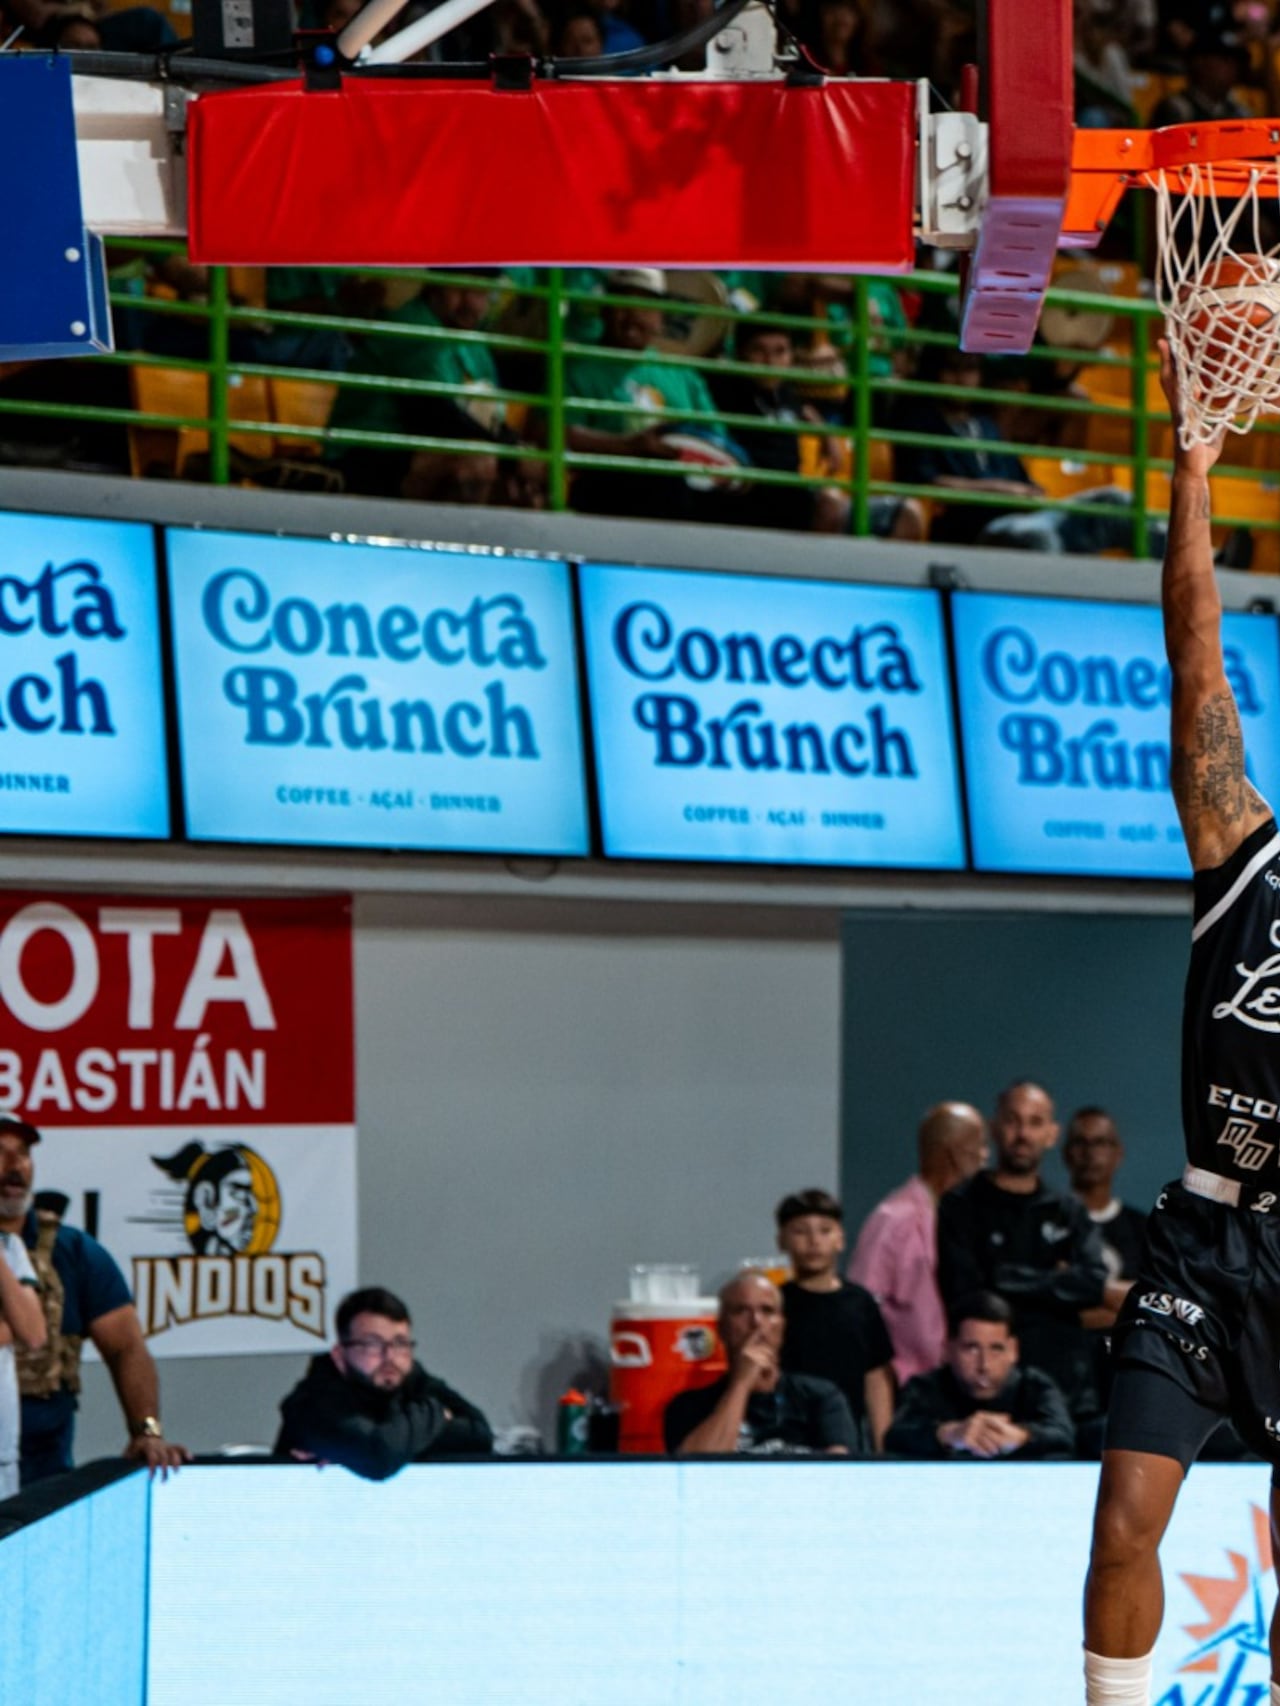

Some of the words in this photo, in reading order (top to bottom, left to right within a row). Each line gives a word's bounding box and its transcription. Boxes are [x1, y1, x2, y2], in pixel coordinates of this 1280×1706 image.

[203, 568, 547, 671] Conecta
[612, 600, 923, 695] Conecta
[0, 651, 117, 737] ch
[223, 666, 540, 759] Brunch
[982, 625, 1263, 716] Conea
[633, 693, 918, 779] Brunch
[276, 784, 350, 805] COFFEE
[430, 793, 503, 813] DINNER
[0, 901, 277, 1032] OTA
[132, 1252, 326, 1339] INDIOS
